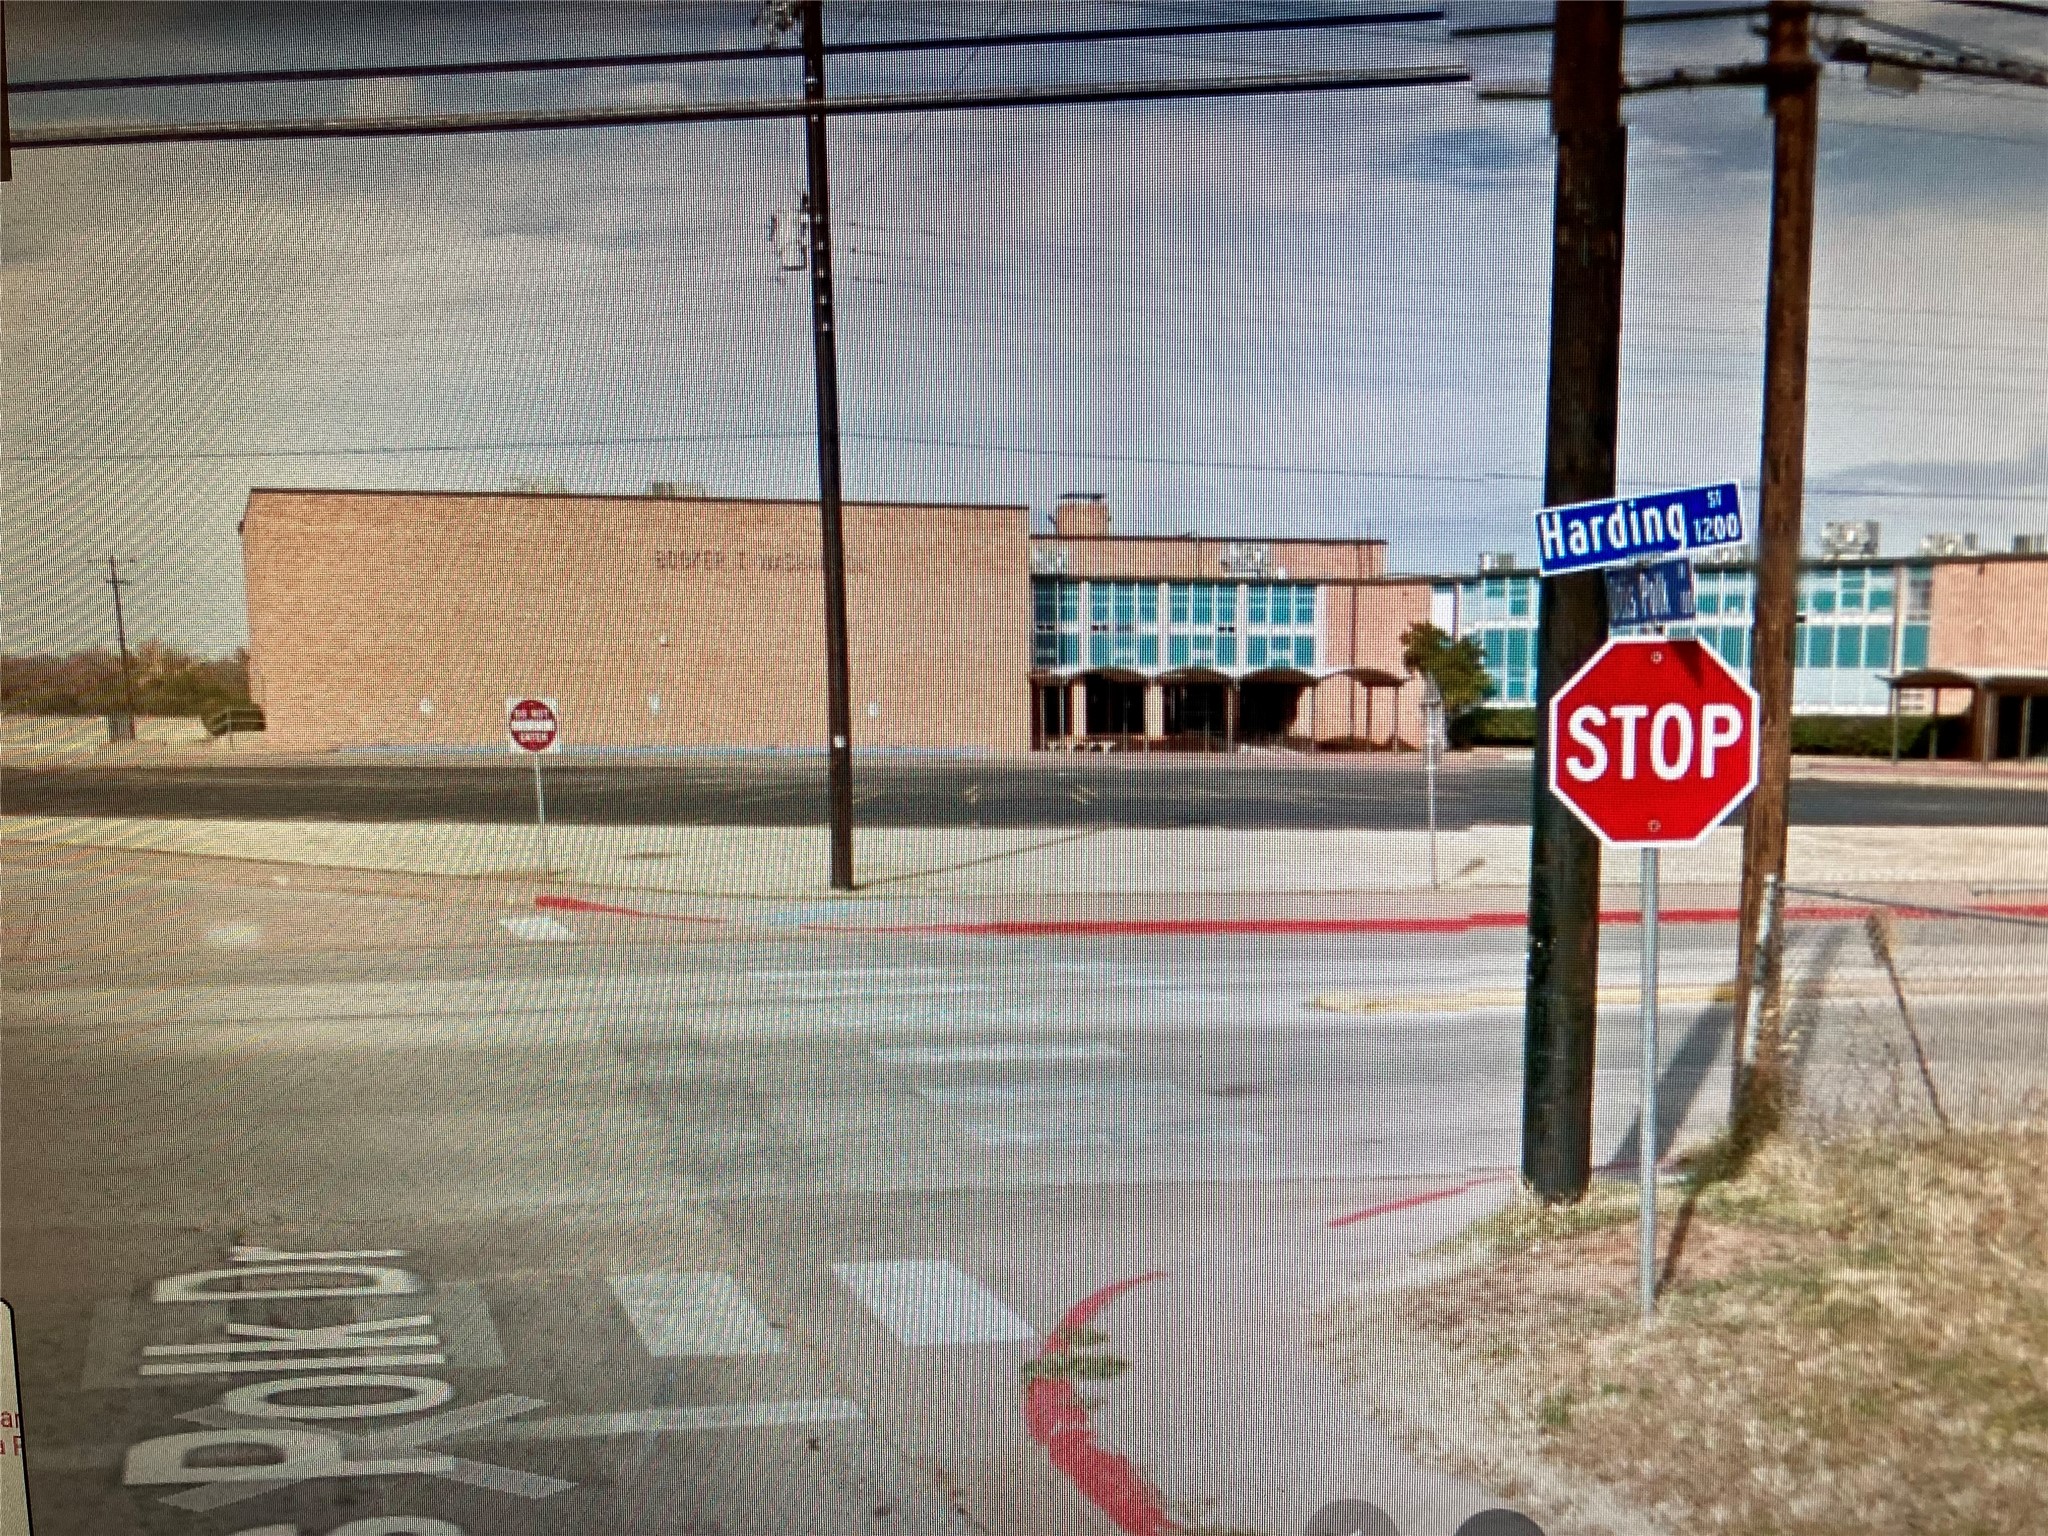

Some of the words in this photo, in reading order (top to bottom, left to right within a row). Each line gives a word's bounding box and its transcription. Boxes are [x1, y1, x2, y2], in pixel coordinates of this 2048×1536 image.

[1541, 500, 1688, 560] Harding
[1693, 512, 1739, 543] 1200
[1565, 702, 1744, 782] STOP
[122, 1314, 456, 1486] Polk
